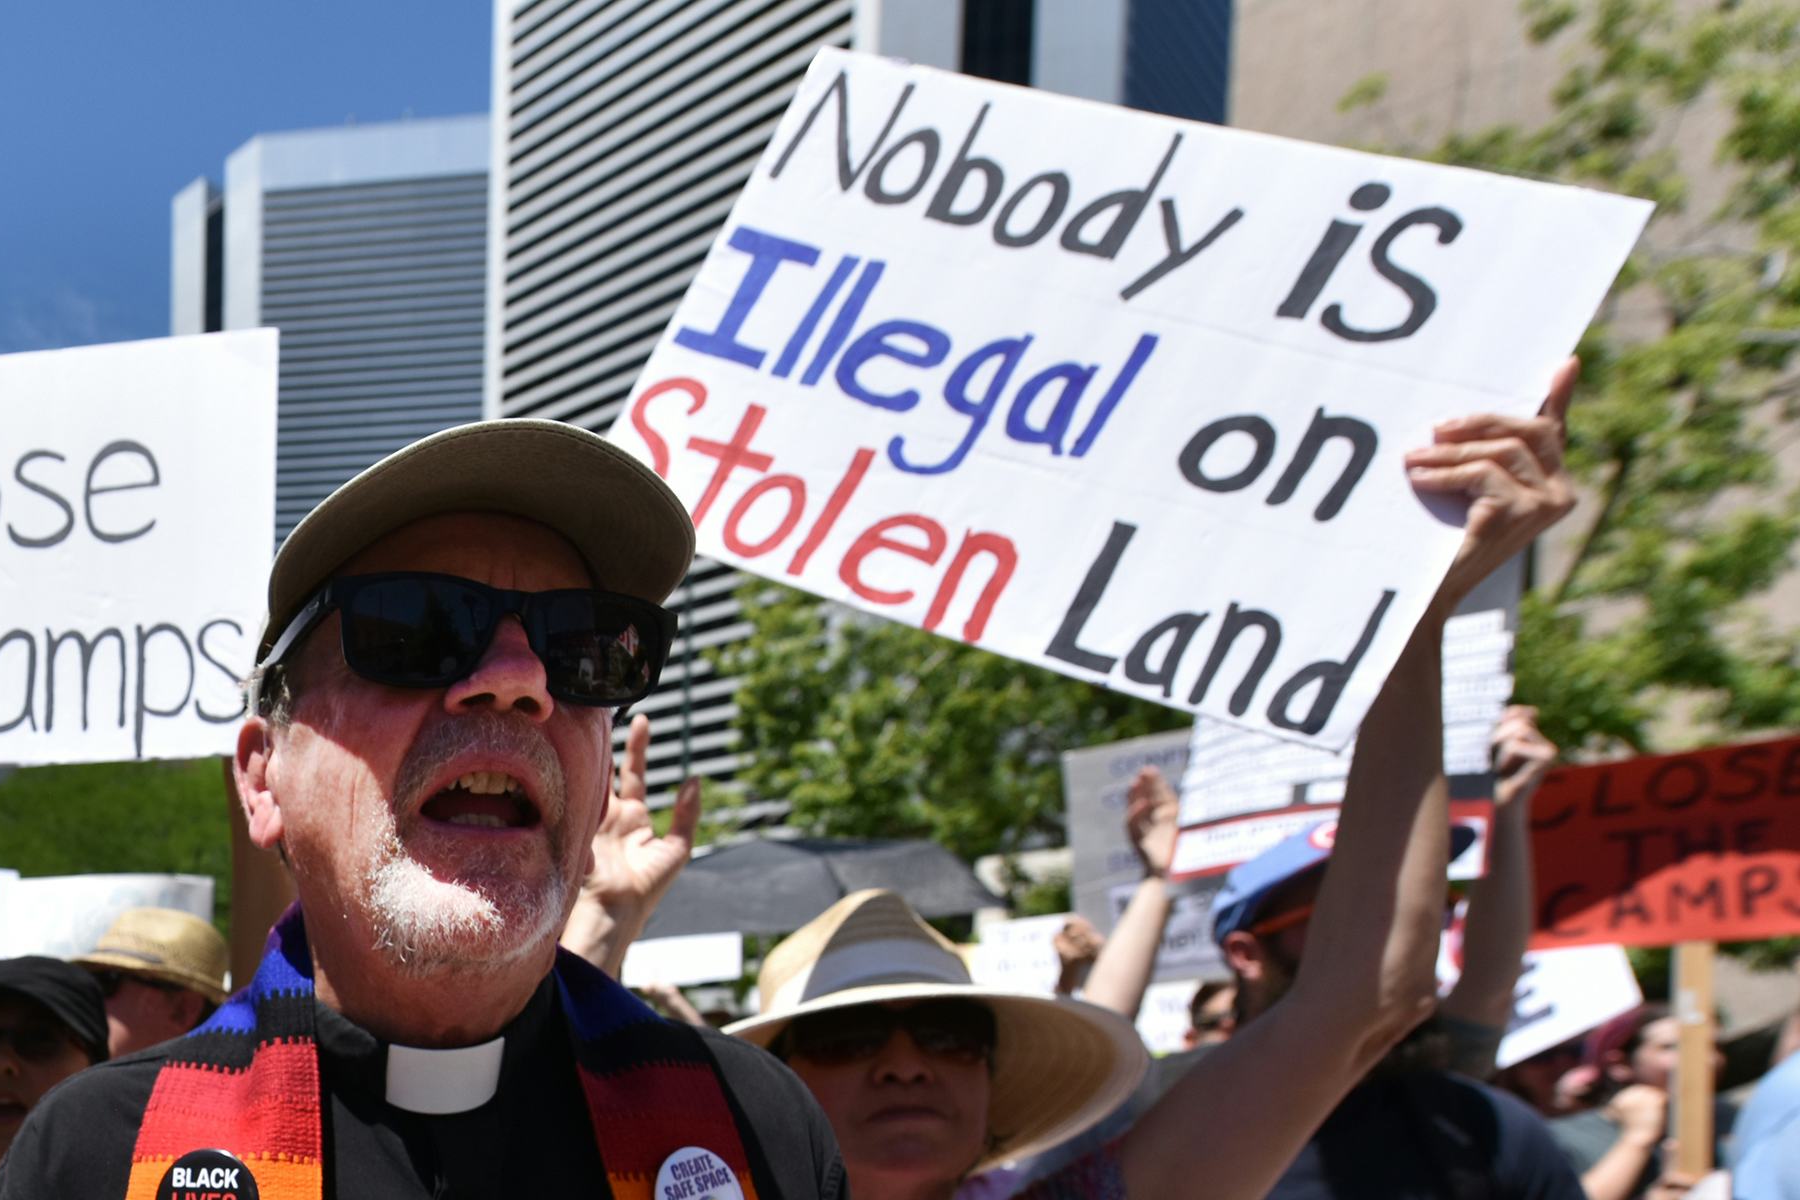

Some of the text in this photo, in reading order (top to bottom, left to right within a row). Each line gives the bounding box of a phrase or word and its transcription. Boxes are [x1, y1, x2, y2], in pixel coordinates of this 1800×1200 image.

[770, 70, 1246, 301] Nobody
[674, 225, 1378, 521] Illegal on
[631, 376, 1018, 643] Stolen
[1044, 519, 1396, 737] Land
[1607, 818, 1773, 895] THE
[172, 1167, 239, 1189] BLACK
[670, 1154, 715, 1180] CREATE
[694, 1167, 731, 1193] SPACE
